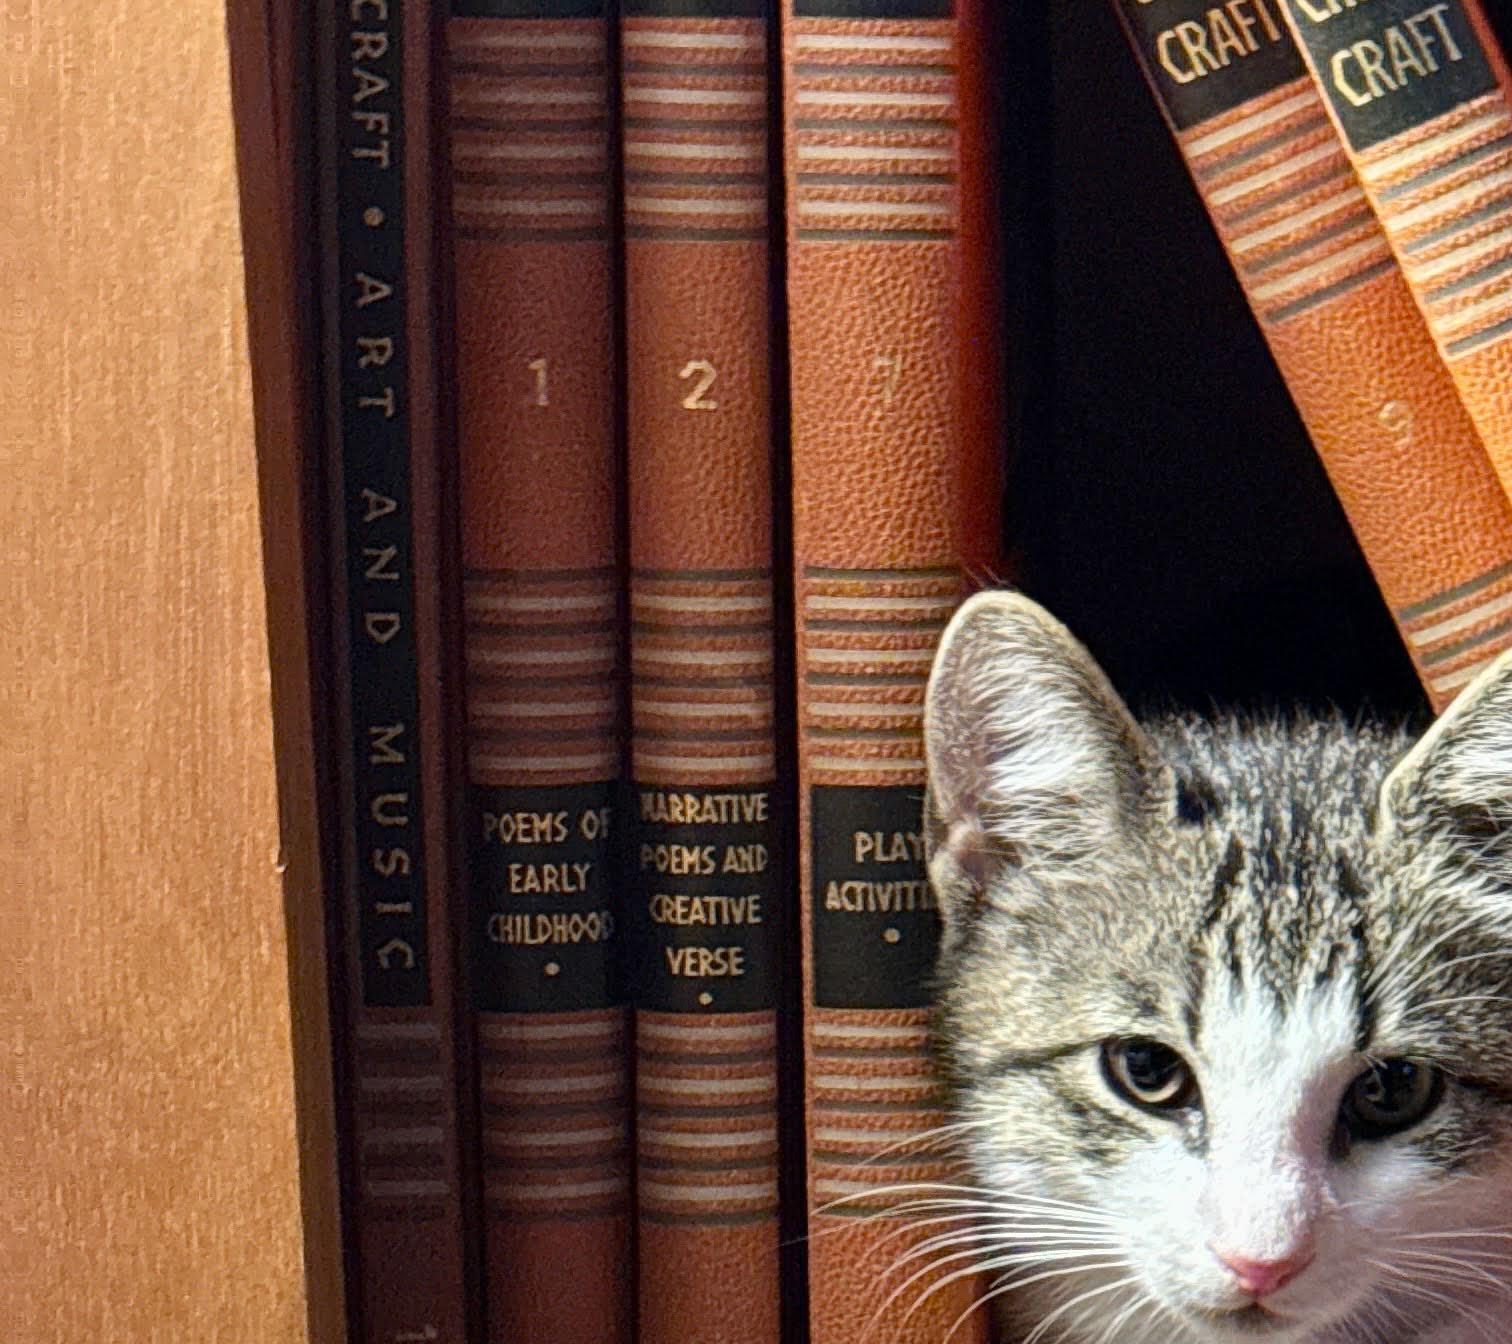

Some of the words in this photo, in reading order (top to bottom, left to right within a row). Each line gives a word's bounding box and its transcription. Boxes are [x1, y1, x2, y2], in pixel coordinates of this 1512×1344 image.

[1330, 2, 1464, 108] CRAFT
[355, 271, 396, 416] ART
[527, 357, 551, 407] 1
[678, 358, 720, 411] 2
[360, 488, 400, 644] AND
[482, 810, 569, 845] POEMS
[580, 807, 611, 841] OF
[639, 792, 769, 825] NARRATIVE
[368, 723, 415, 969] MUSIC
[640, 843, 716, 875] POEMS
[723, 843, 769, 874] AND
[507, 862, 592, 894] EARLY
[650, 894, 763, 926] CREATIVE
[824, 880, 935, 913] ACTIVITI
[487, 911, 616, 945] CHILDHOOD
[666, 946, 746, 977] VERSE
